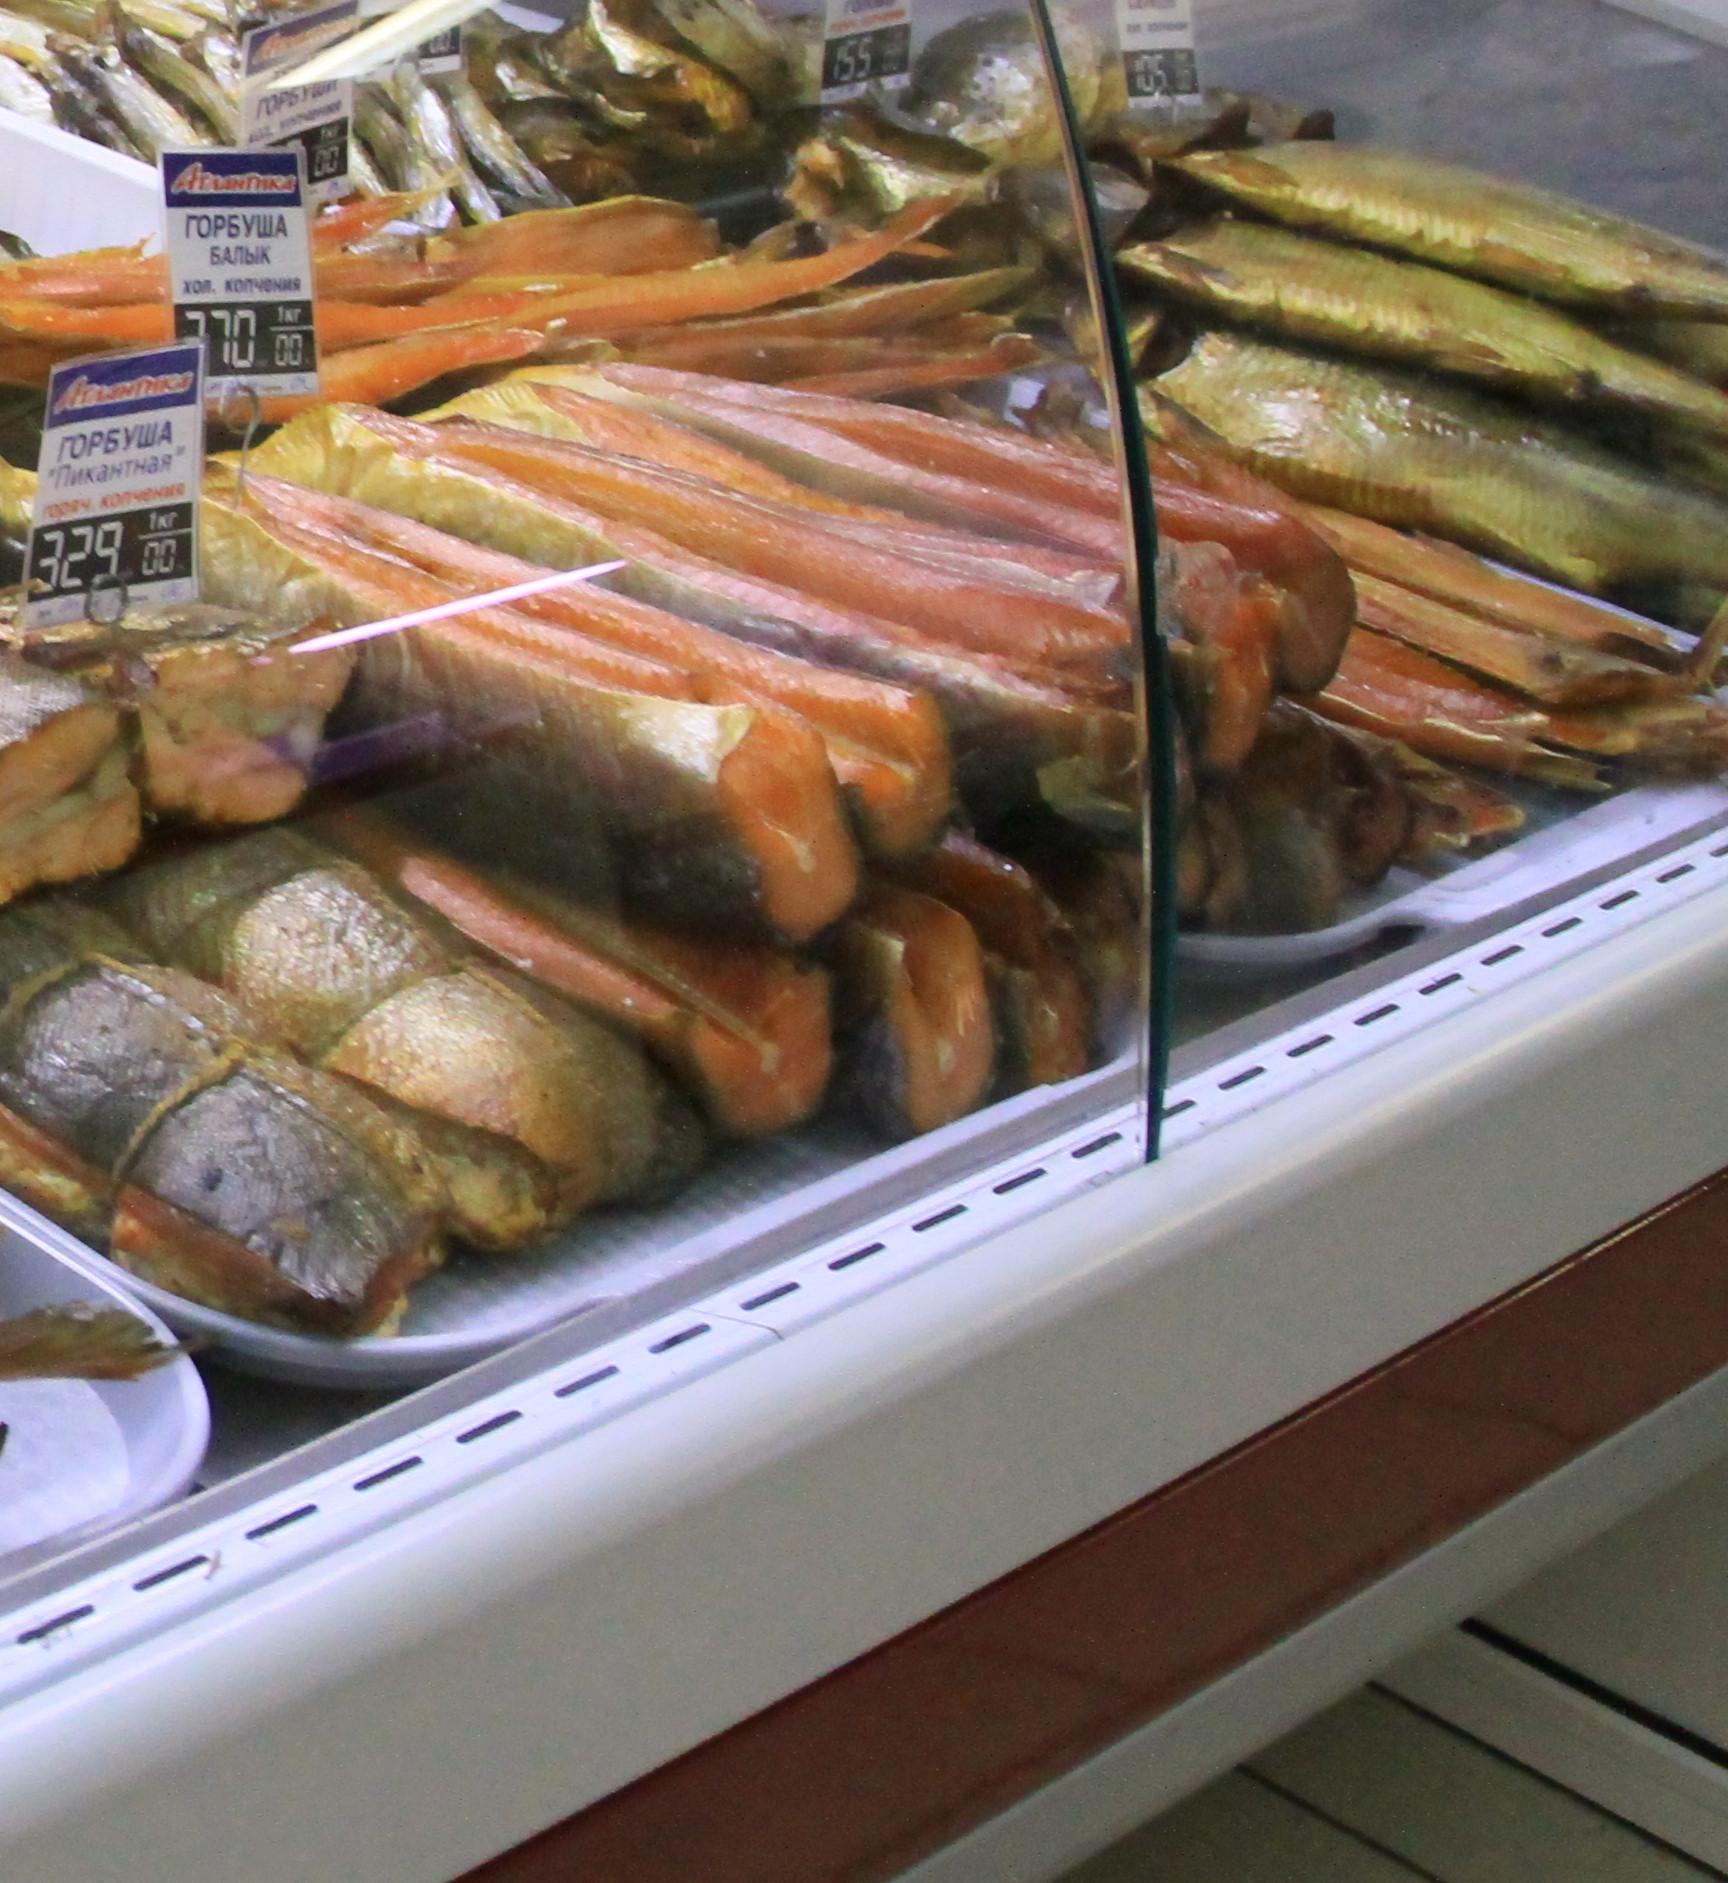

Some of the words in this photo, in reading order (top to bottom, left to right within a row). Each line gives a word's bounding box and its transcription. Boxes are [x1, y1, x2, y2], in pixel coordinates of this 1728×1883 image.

[185, 214, 288, 239] ГОРБУША
[209, 245, 271, 265] БАЛЫК
[278, 305, 302, 324] 1кг
[275, 333, 303, 367] 00
[57, 420, 172, 463] ГОРБУША
[149, 511, 179, 531] 1кг
[38, 521, 124, 588] 329
[141, 538, 179, 576] 00
